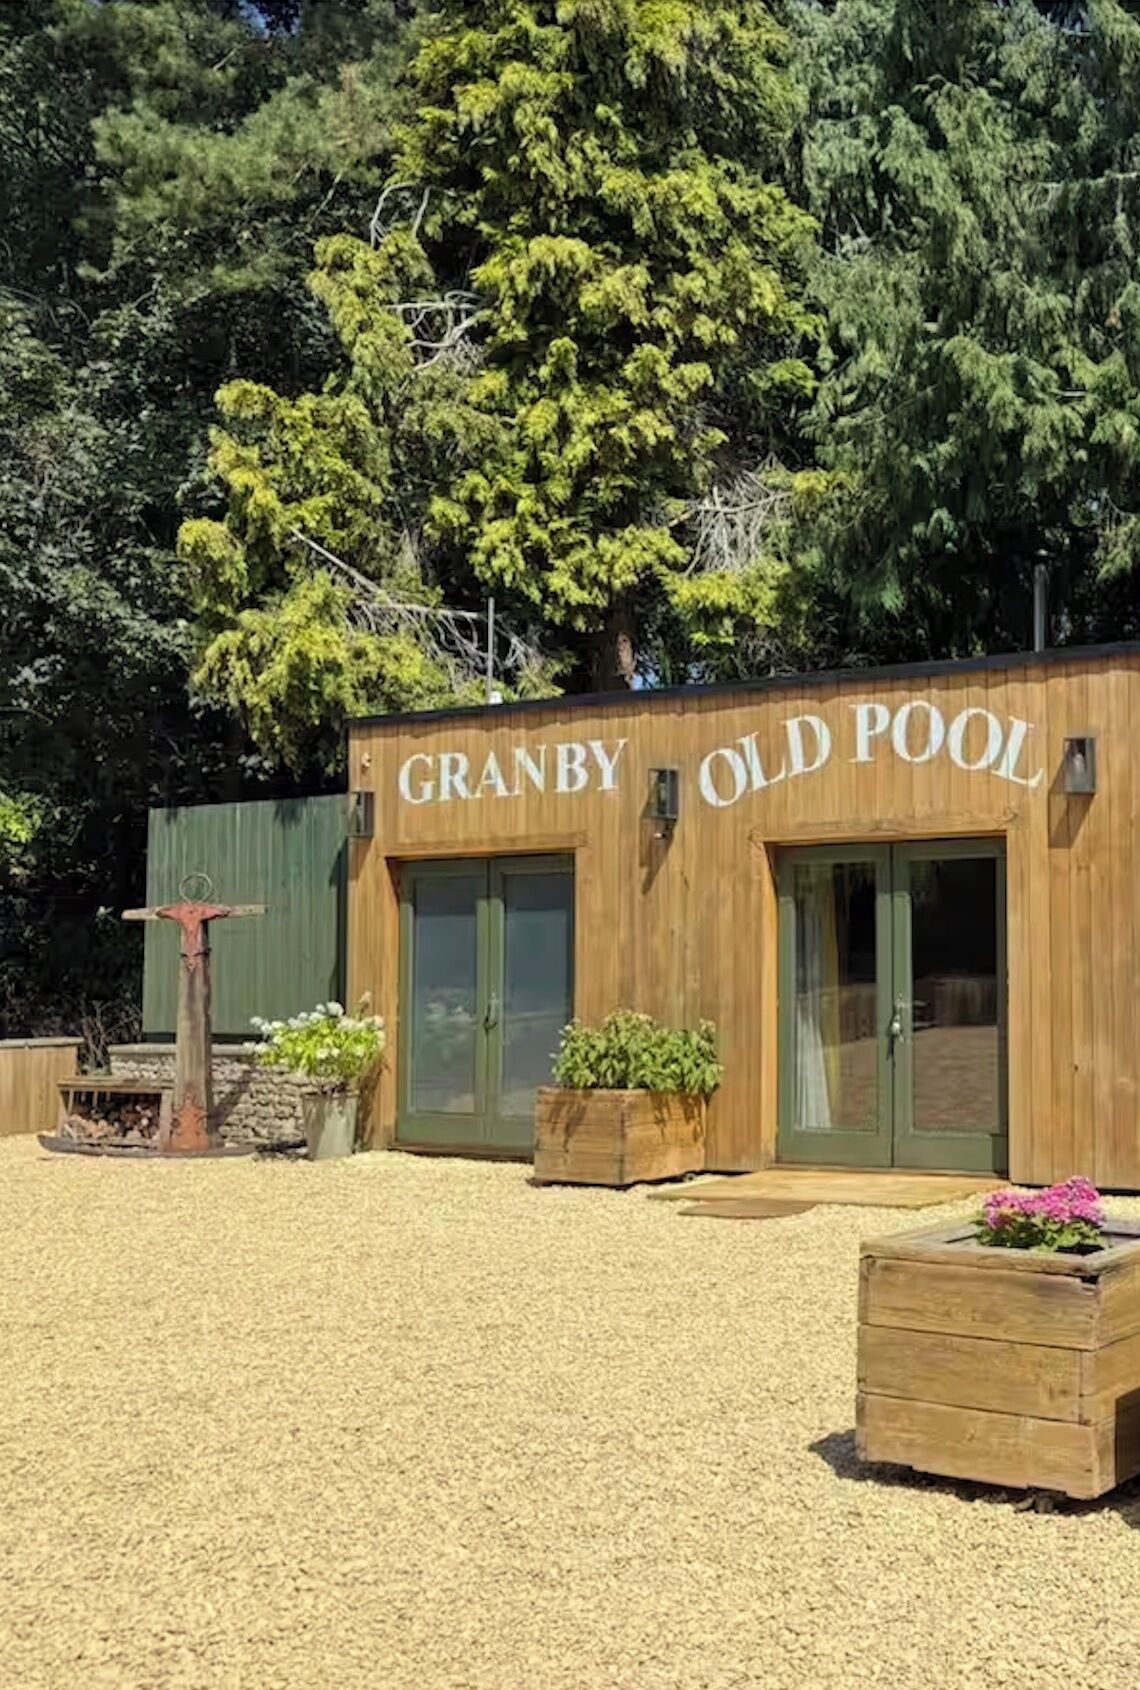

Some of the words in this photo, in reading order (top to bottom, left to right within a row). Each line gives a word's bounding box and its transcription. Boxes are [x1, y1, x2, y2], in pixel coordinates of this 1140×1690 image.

[398, 737, 628, 804] GRANBY
[699, 714, 832, 809] OLD
[849, 699, 1045, 789] POOL
